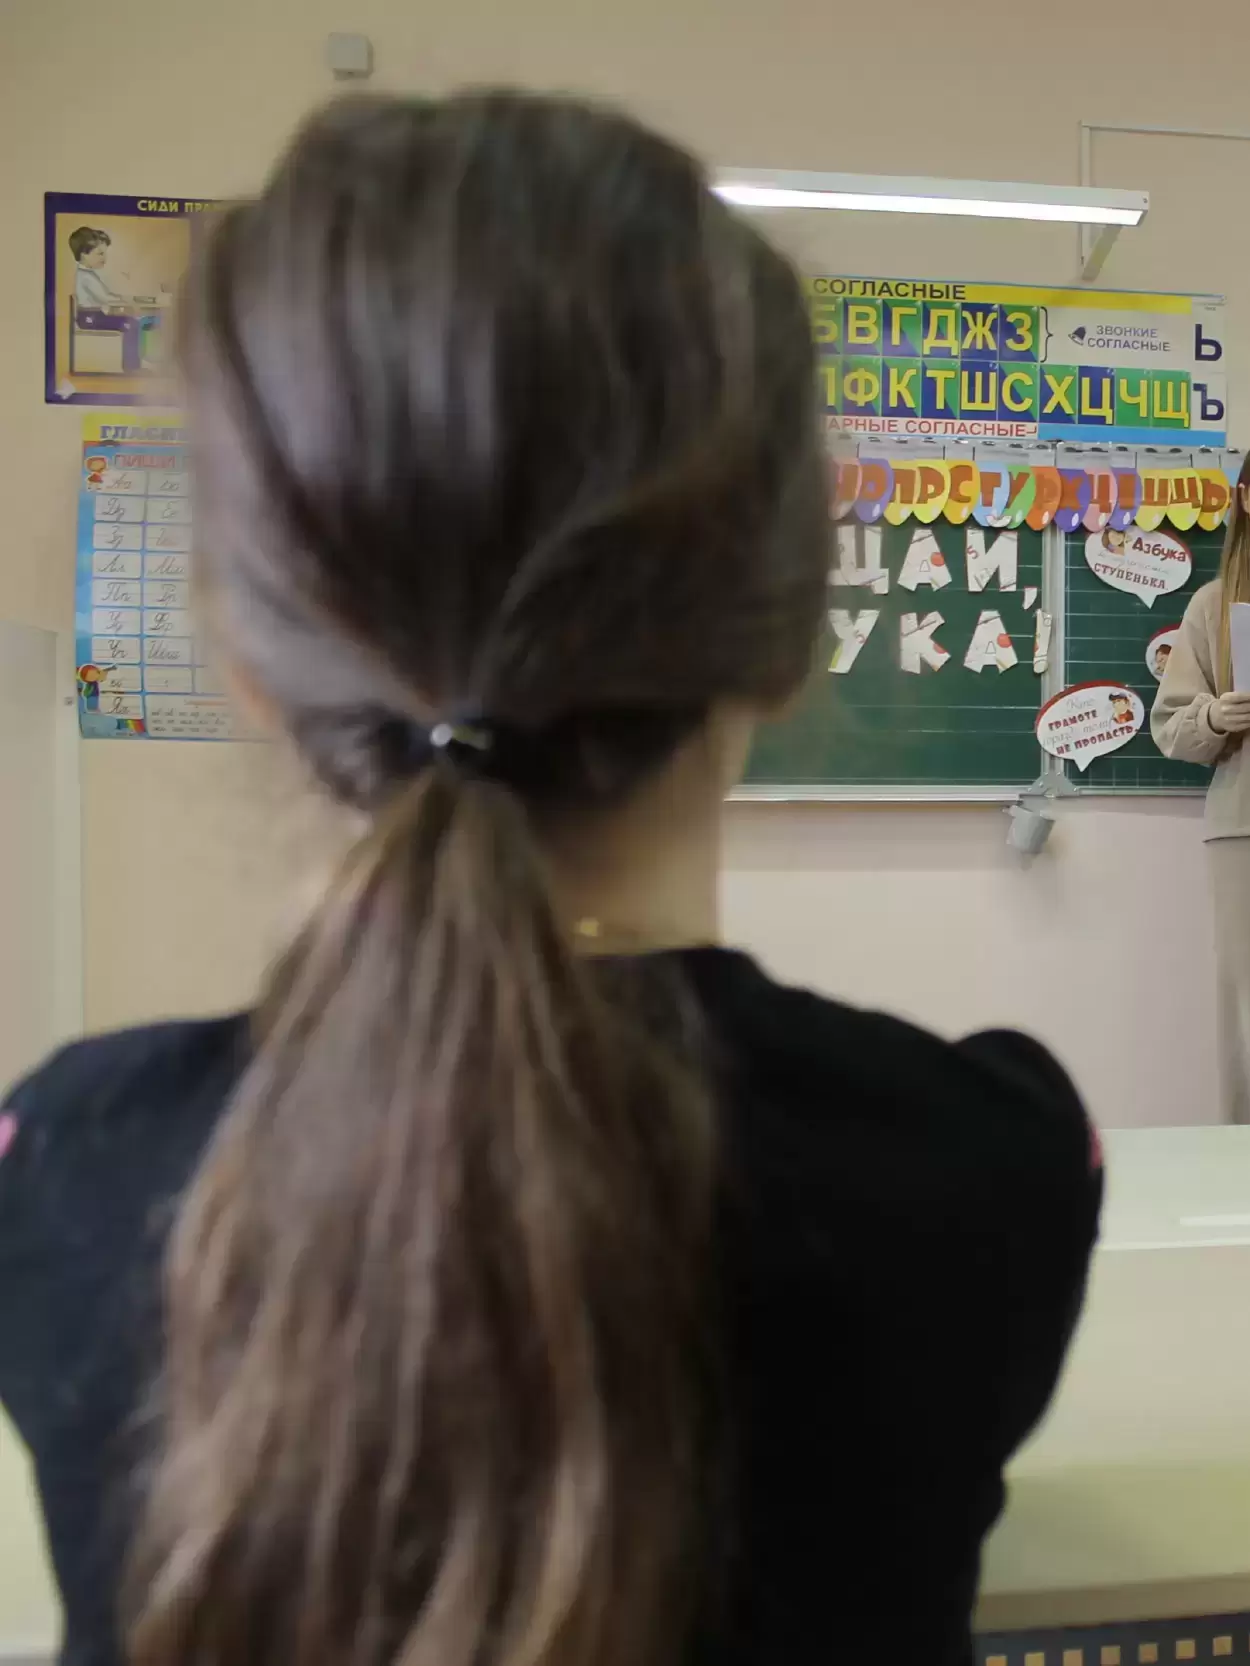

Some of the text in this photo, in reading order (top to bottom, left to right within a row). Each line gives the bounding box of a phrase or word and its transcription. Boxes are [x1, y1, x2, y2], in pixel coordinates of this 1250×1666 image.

[137, 199, 179, 212] СИДИ
[813, 279, 966, 300] СОГЛАСНЫЕ
[1096, 325, 1158, 338] ЗВОНКИЕ
[1087, 338, 1171, 352] СОГЛАСНЫЕ
[824, 418, 1025, 436] АРНЫЕ СОГЛАСНЫЕ
[1132, 537, 1186, 561] Азбука
[827, 608, 1052, 674] УКА!
[1048, 710, 1098, 731] ГРАМОТЕ
[1056, 744, 1071, 755] НЕ
